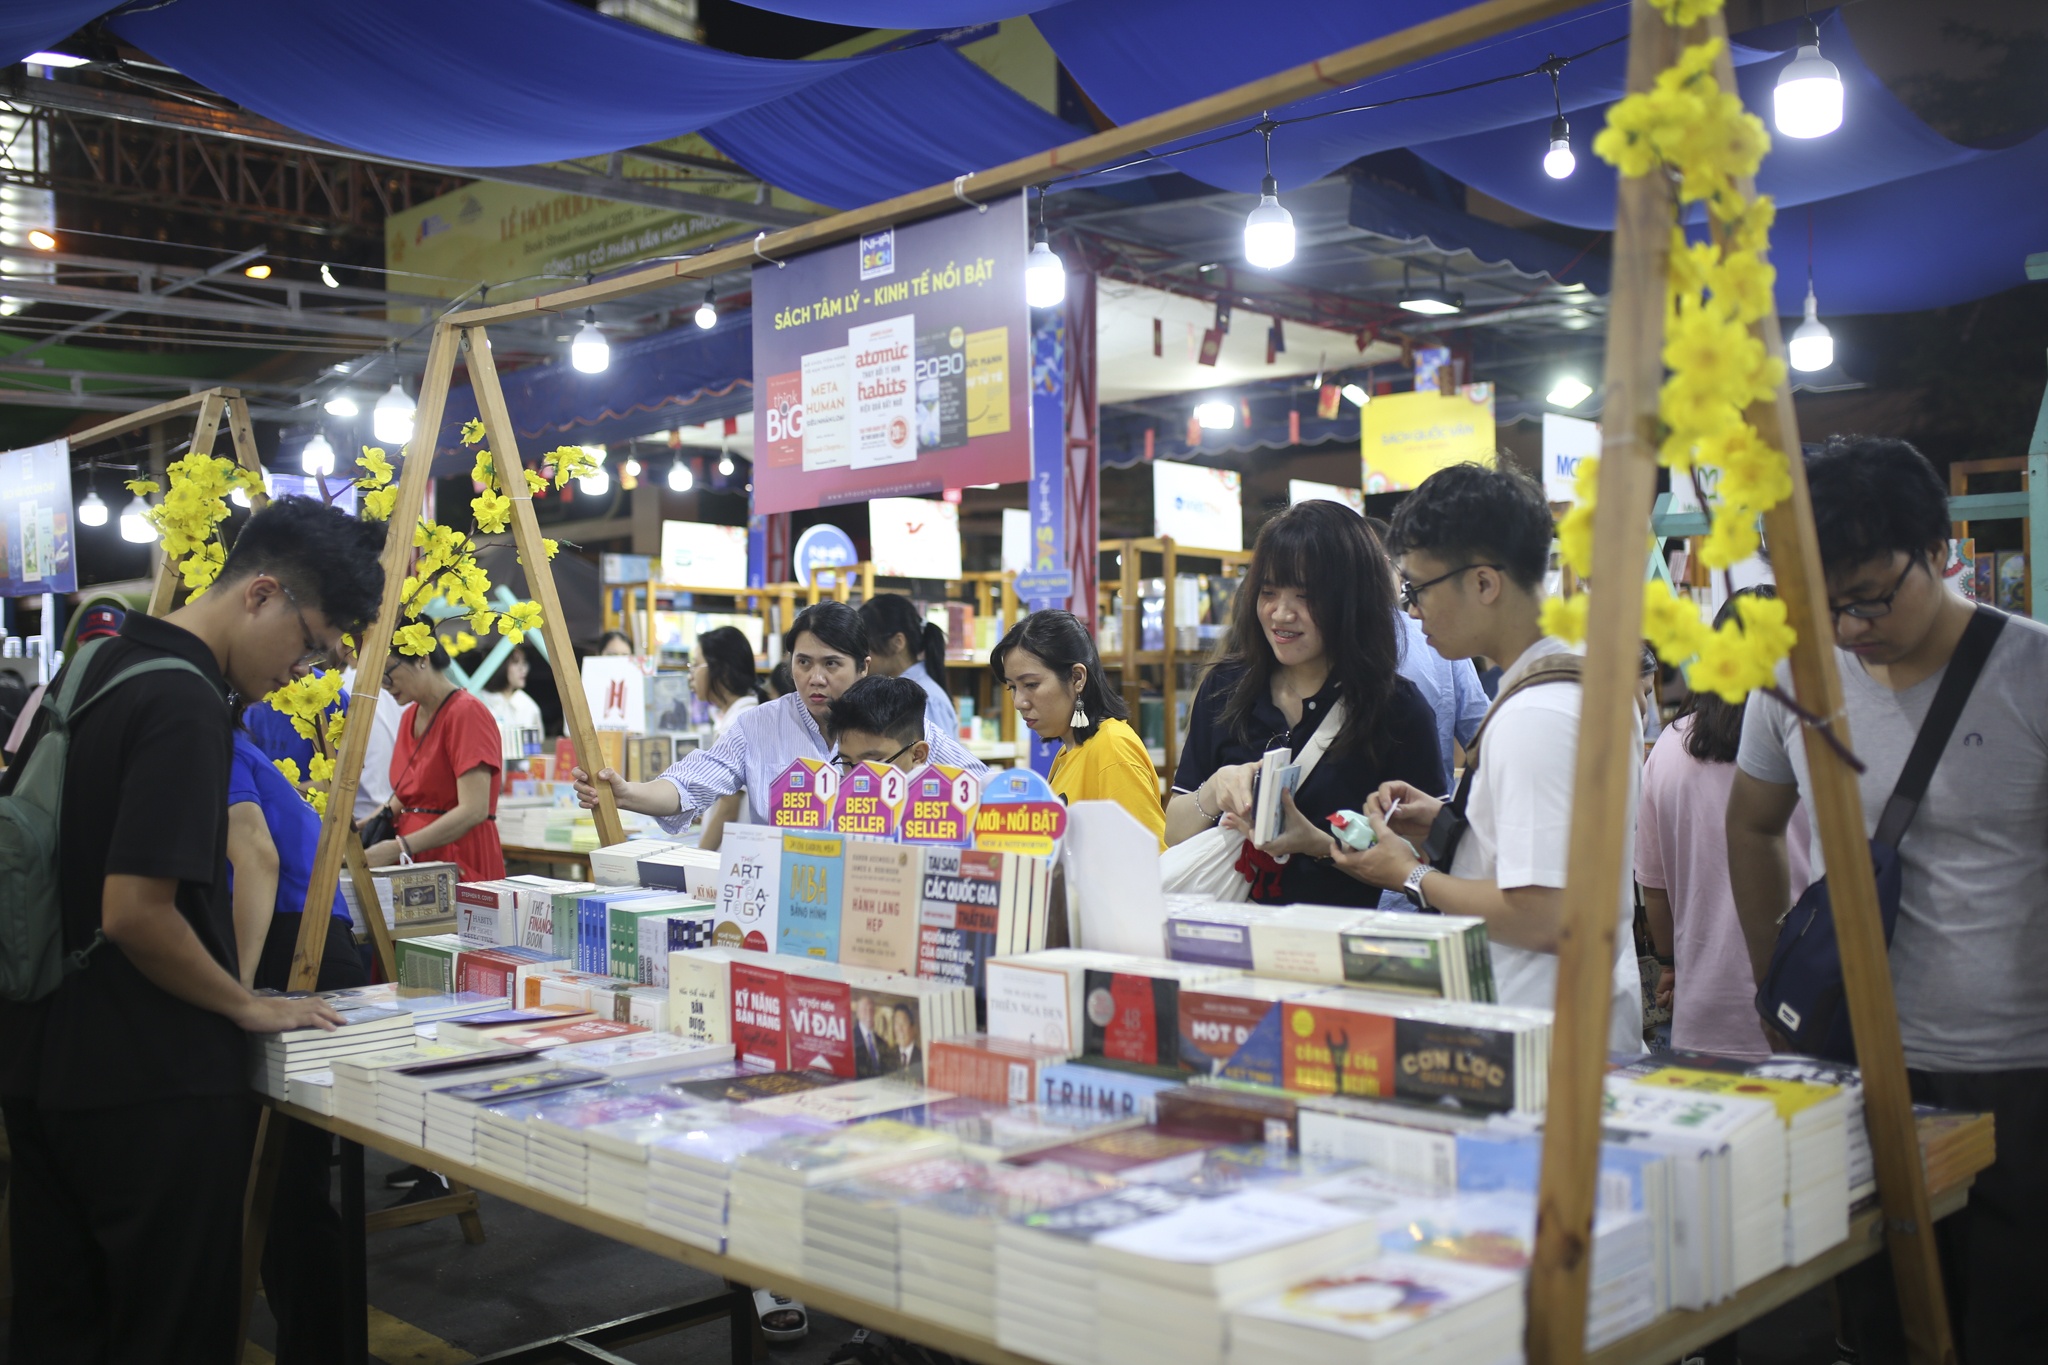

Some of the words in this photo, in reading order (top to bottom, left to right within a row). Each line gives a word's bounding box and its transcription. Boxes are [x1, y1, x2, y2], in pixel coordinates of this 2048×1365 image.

[775, 306, 811, 331] SÁCH
[813, 297, 842, 321] TÂM
[845, 288, 860, 313] LÝ
[874, 281, 909, 306] KINH
[911, 268, 930, 297] TẾ
[932, 261, 961, 292] NỔI
[965, 257, 995, 287] BẬT
[856, 341, 909, 369] atomic
[915, 352, 964, 382] 2030
[811, 381, 839, 397] META
[858, 377, 907, 401] habits
[806, 397, 845, 415] HUMAN
[822, 772, 828, 794] 1
[888, 776, 897, 799] 2
[960, 780, 969, 803] 3
[783, 792, 812, 809] BEST
[846, 797, 878, 814] BEST
[914, 801, 949, 819] BEST
[776, 810, 819, 827] SELLER
[838, 816, 886, 833] SELLER
[976, 808, 1000, 831] MỚI
[1007, 804, 1030, 832] NỔI
[1031, 808, 1060, 836] BẬT
[905, 821, 958, 840] SELLER
[730, 862, 763, 880] ART
[941, 857, 959, 873] SAO
[461, 891, 478, 899] STEPHEN
[789, 863, 828, 906] MBA
[924, 876, 945, 900] CÁC
[947, 876, 976, 904] QUỐC
[977, 885, 998, 906] GIA
[531, 900, 544, 916] THE
[877, 901, 900, 916] LANG
[463, 909, 472, 932] 7
[472, 914, 493, 926] HABITS
[525, 931, 544, 950] BOOK
[735, 988, 749, 1008] KỸ
[751, 991, 780, 1016] NĂNG
[735, 1007, 755, 1025] BÁN
[756, 1011, 780, 1032] HÀNG
[812, 1011, 846, 1042] ĐẠI
[1121, 1006, 1142, 1031] 48
[1044, 1076, 1134, 1113] TRUMP
